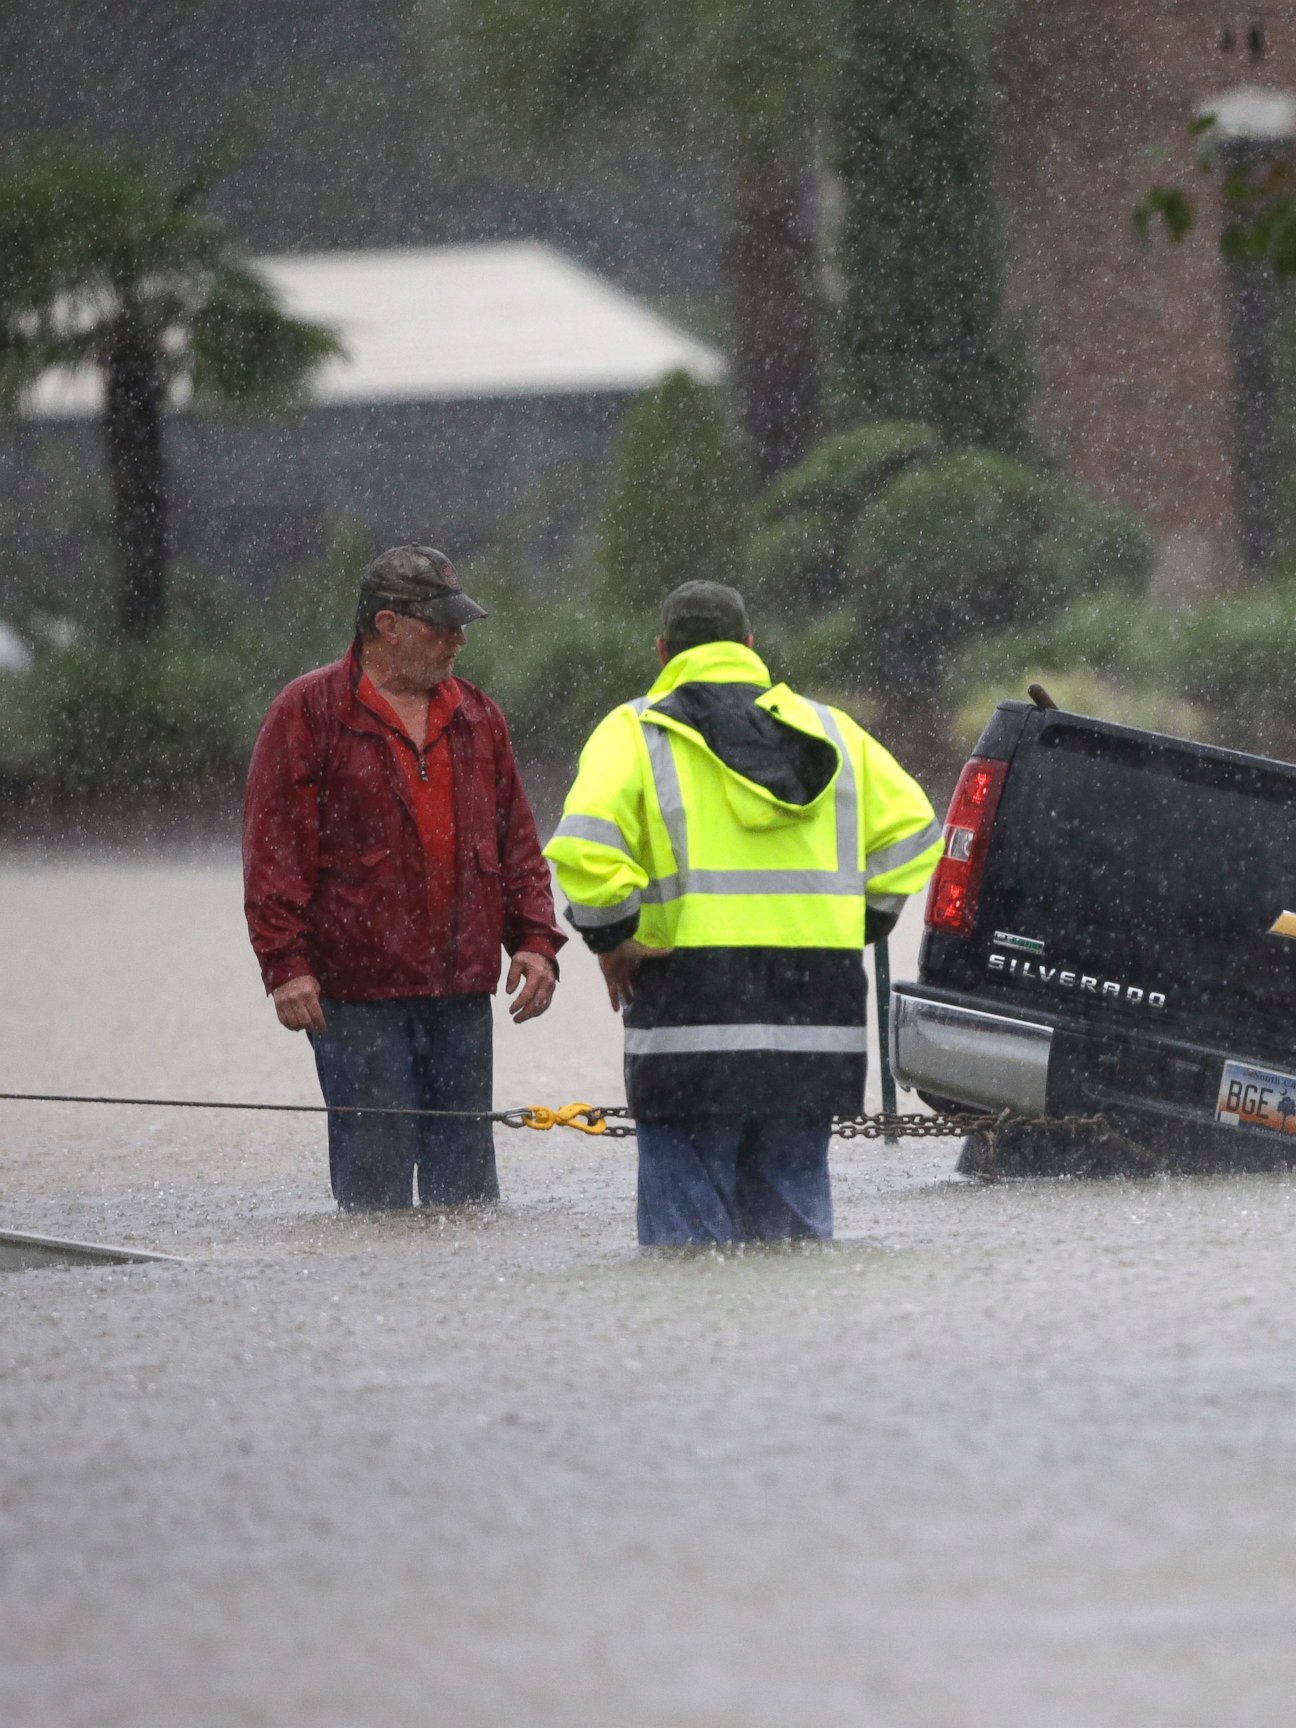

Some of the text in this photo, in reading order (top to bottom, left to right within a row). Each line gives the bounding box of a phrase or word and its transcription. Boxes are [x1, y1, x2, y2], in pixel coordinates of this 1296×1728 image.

[988, 954, 1165, 1008] SILVERADO
[1254, 1071, 1280, 1085] South
[1226, 1080, 1273, 1119] BGE
